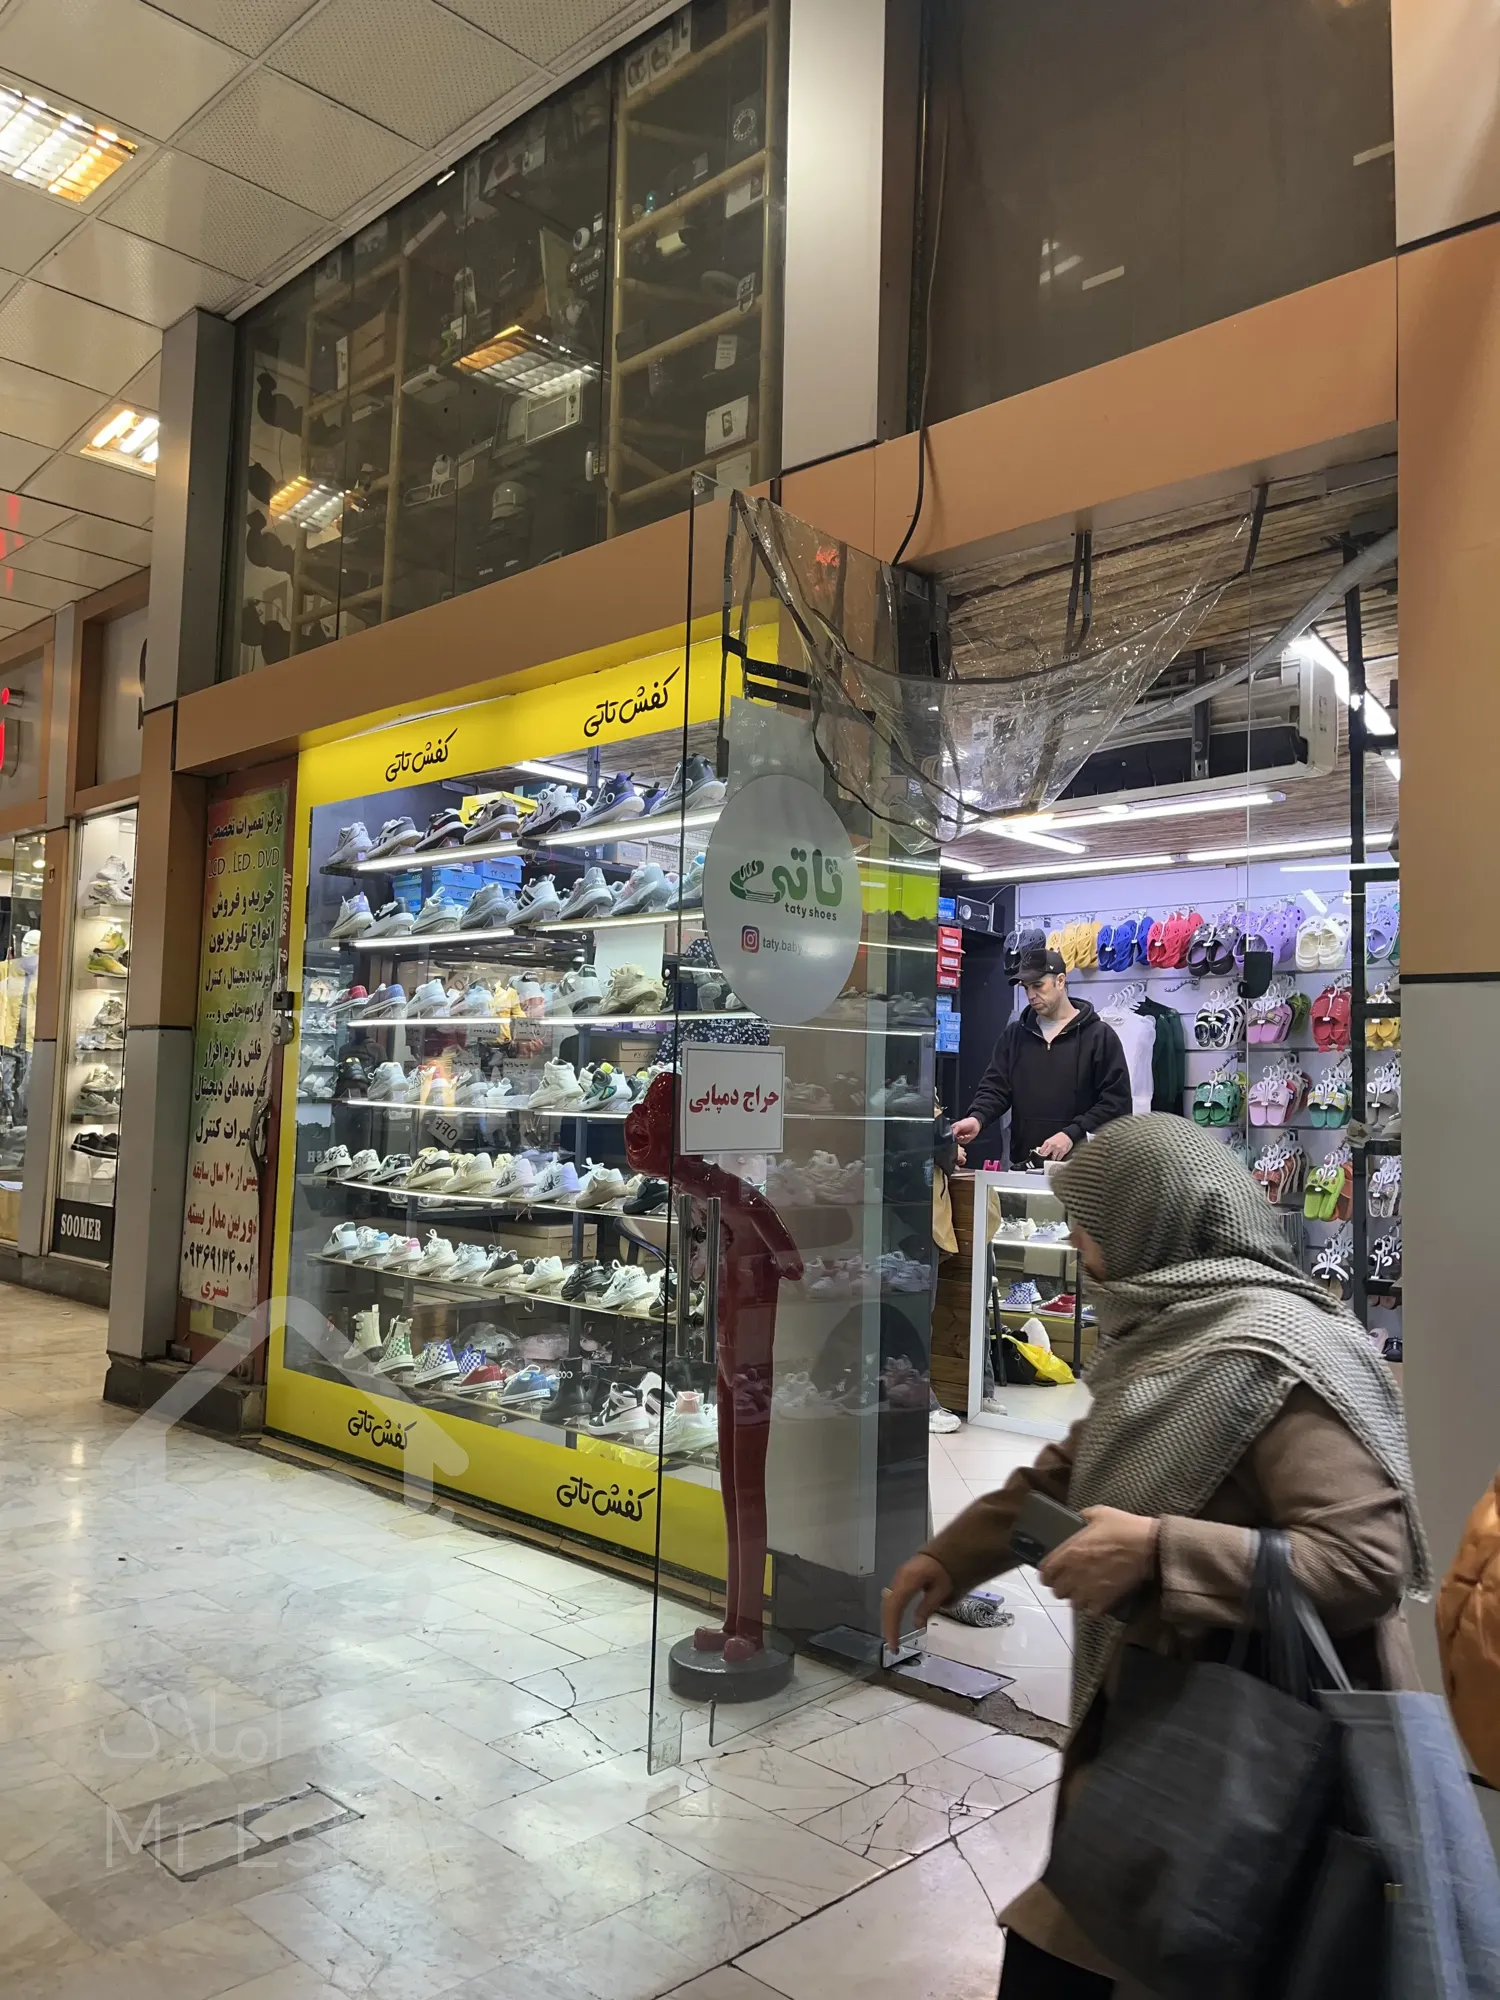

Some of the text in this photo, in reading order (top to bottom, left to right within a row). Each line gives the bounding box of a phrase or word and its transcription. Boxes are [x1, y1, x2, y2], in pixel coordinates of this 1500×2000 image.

[584, 666, 680, 737] کفش تاتی
[386, 728, 458, 782] کفش تاتی
[237, 811, 265, 839] تعمیرات
[265, 807, 283, 834] مرکز
[208, 858, 225, 877] LCD
[233, 853, 251, 873] LED
[258, 848, 280, 869] DVD
[729, 847, 843, 907] تاتی
[212, 881, 275, 919] خرید و فروش
[785, 902, 837, 921] taty shoes
[209, 919, 275, 953] انواع تلویزیون
[206, 968, 223, 992] کنترل
[222, 1001, 243, 1024] جانبی
[244, 1001, 264, 1023] لوازم
[203, 1037, 261, 1068] فلش و نرم افزار
[195, 1074, 267, 1104] گیرنده های دیجیتال
[689, 1083, 780, 1114] حراج دمپایی
[196, 1116, 222, 1144] کنترل
[192, 1161, 209, 1184] سابقه
[210, 1161, 224, 1187] سال
[225, 1162, 234, 1184] ۲۰
[235, 1165, 243, 1191] از
[60, 1213, 101, 1242] SOOMER
[188, 1203, 205, 1233] بسته
[206, 1201, 226, 1235] مدار
[348, 1410, 417, 1450] کفش تاتی
[556, 1477, 656, 1522] کفش تاتی
